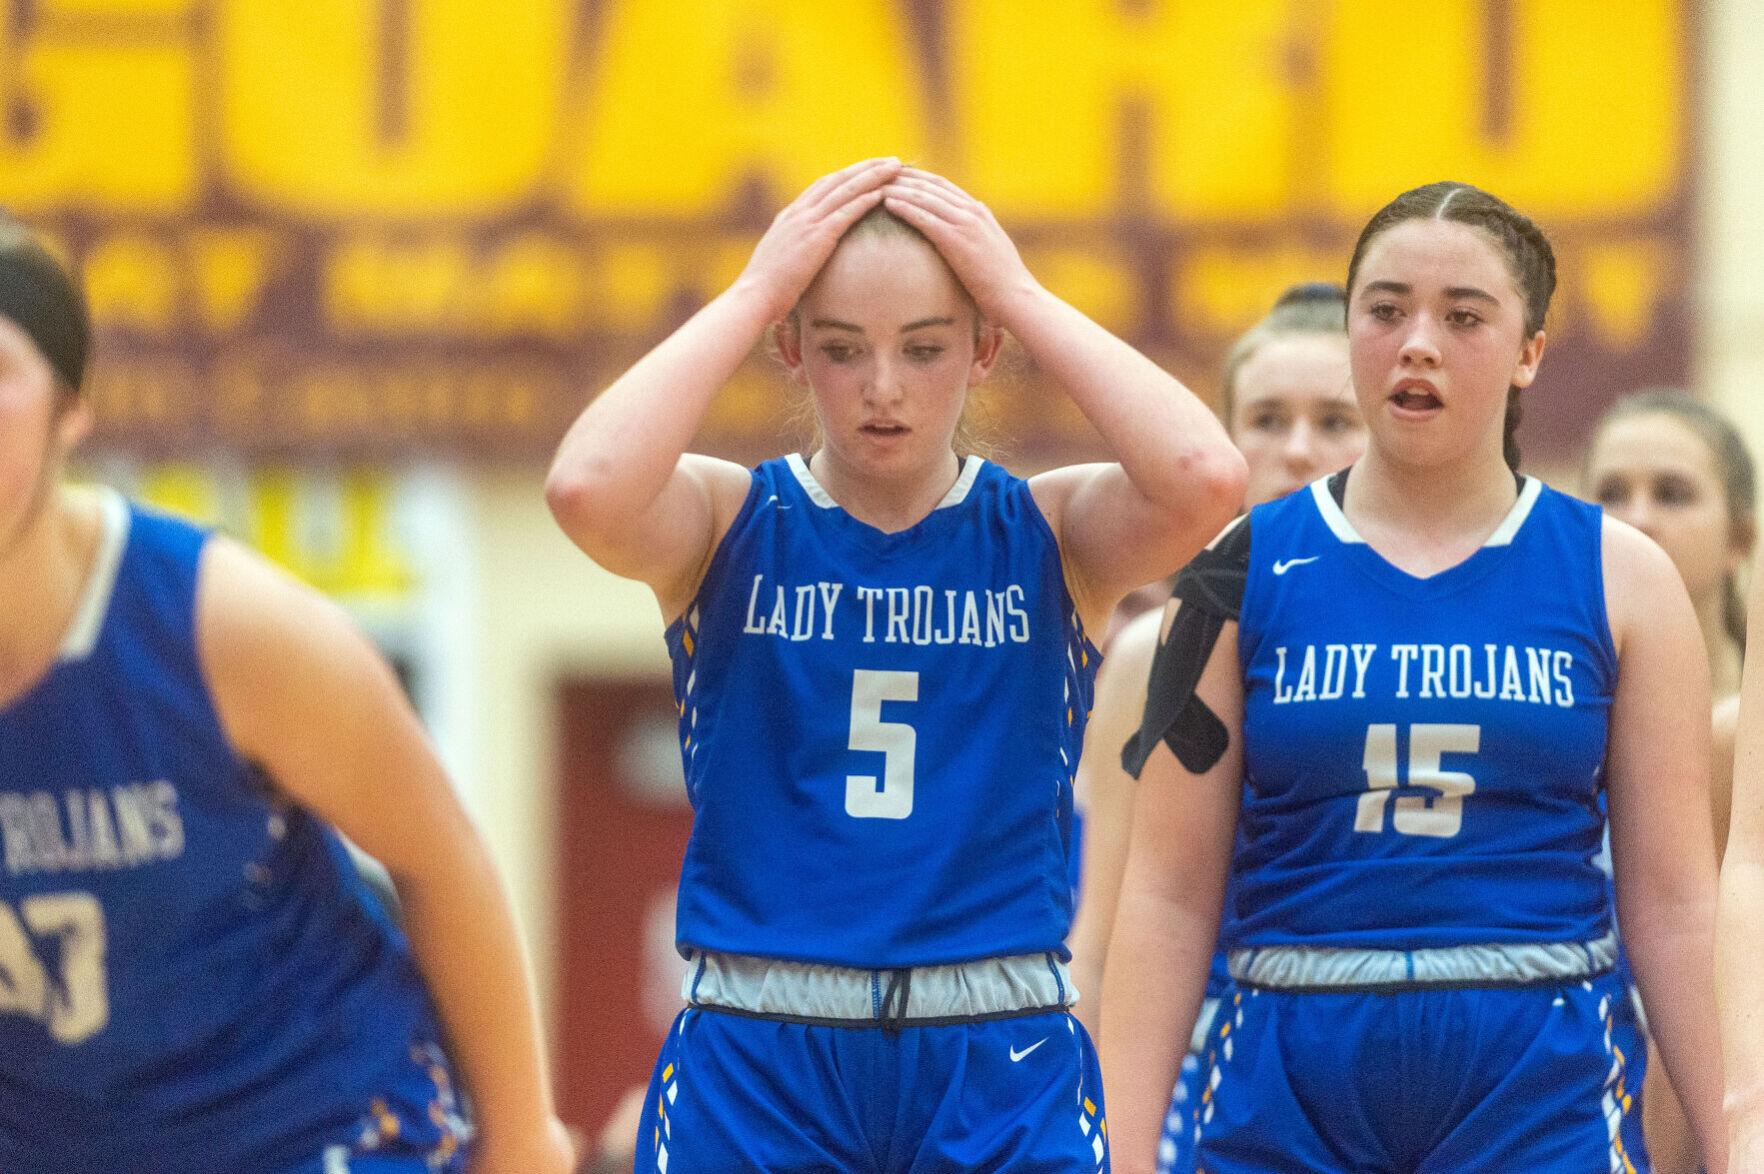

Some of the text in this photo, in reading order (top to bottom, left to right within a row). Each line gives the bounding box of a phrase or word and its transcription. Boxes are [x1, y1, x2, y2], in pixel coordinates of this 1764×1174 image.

[743, 574, 1030, 648] LADY TROJANS
[1273, 643, 1575, 708] LADY TROJANS
[844, 668, 919, 820] 5
[1354, 723, 1481, 839] 15
[0, 780, 184, 873] ROJANS
